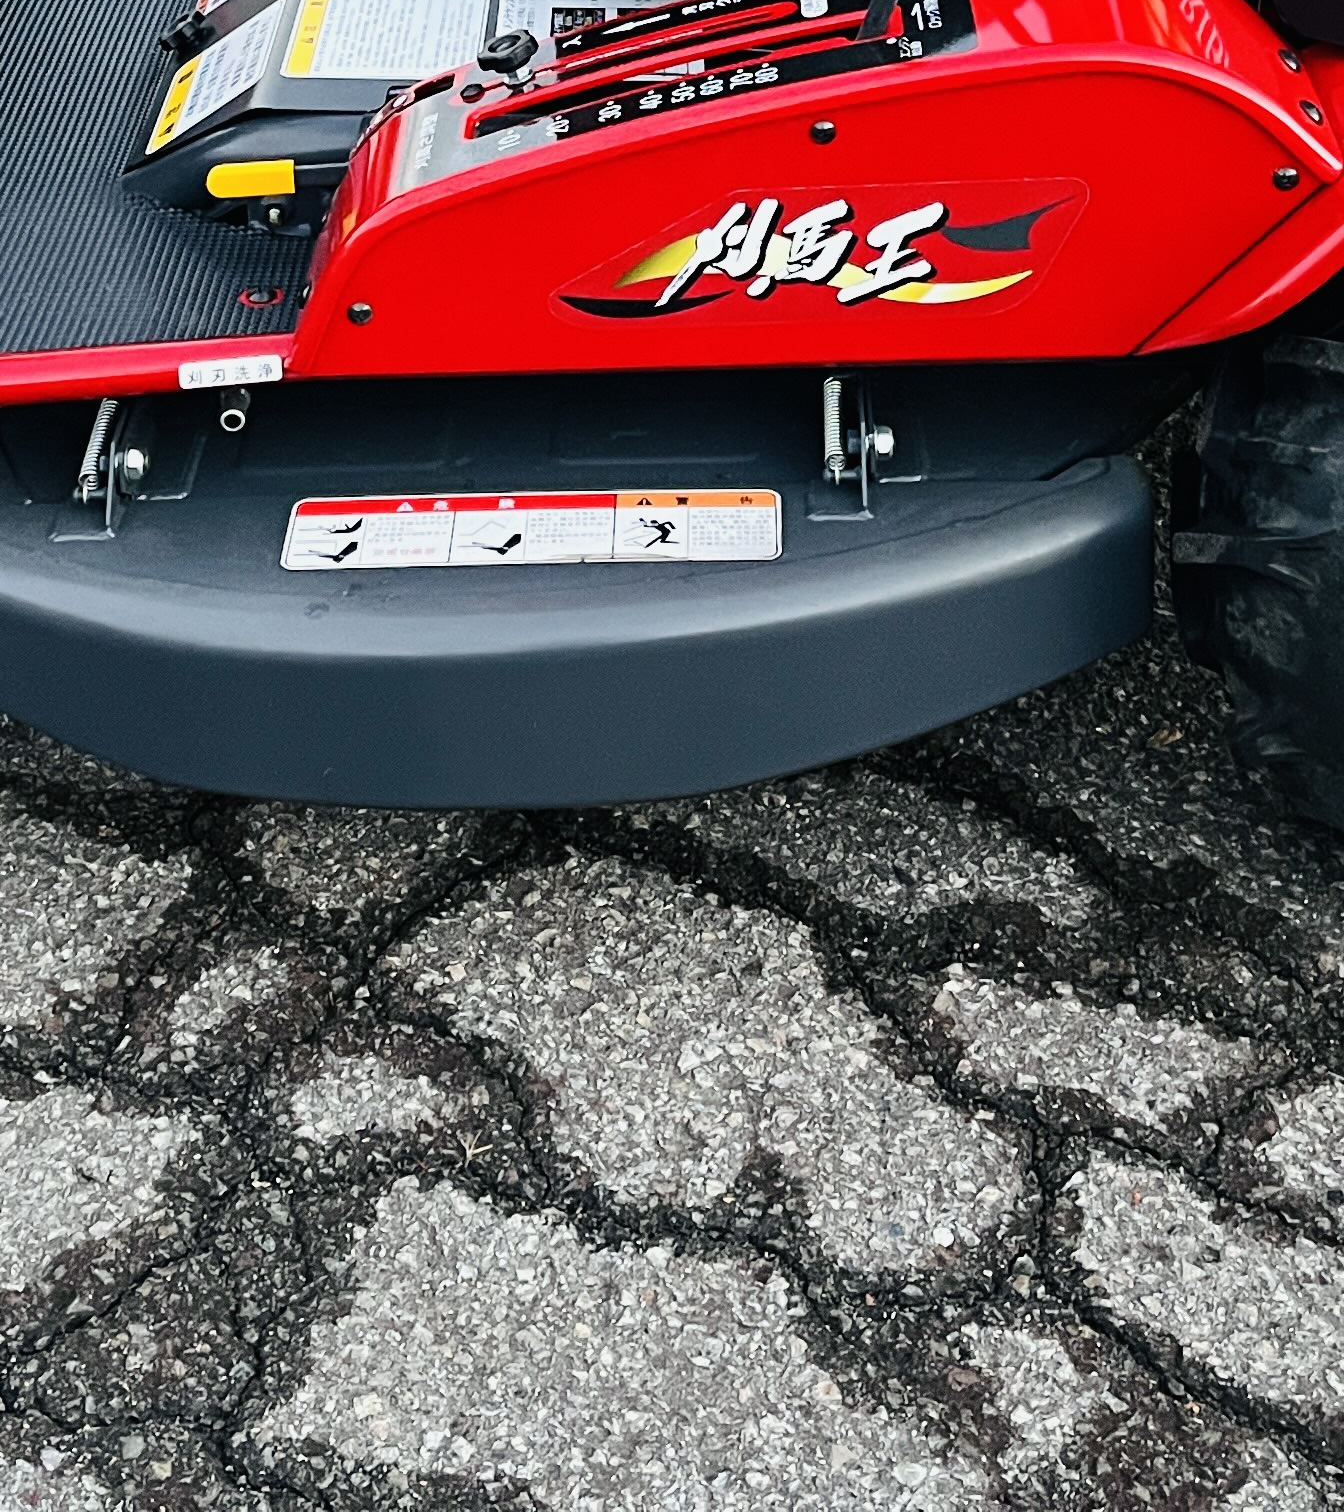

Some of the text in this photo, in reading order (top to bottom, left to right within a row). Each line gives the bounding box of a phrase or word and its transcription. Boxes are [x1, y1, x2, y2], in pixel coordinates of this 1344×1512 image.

[654, 197, 946, 308] 刈馬王
[187, 364, 273, 385] 刈刃洗浄
